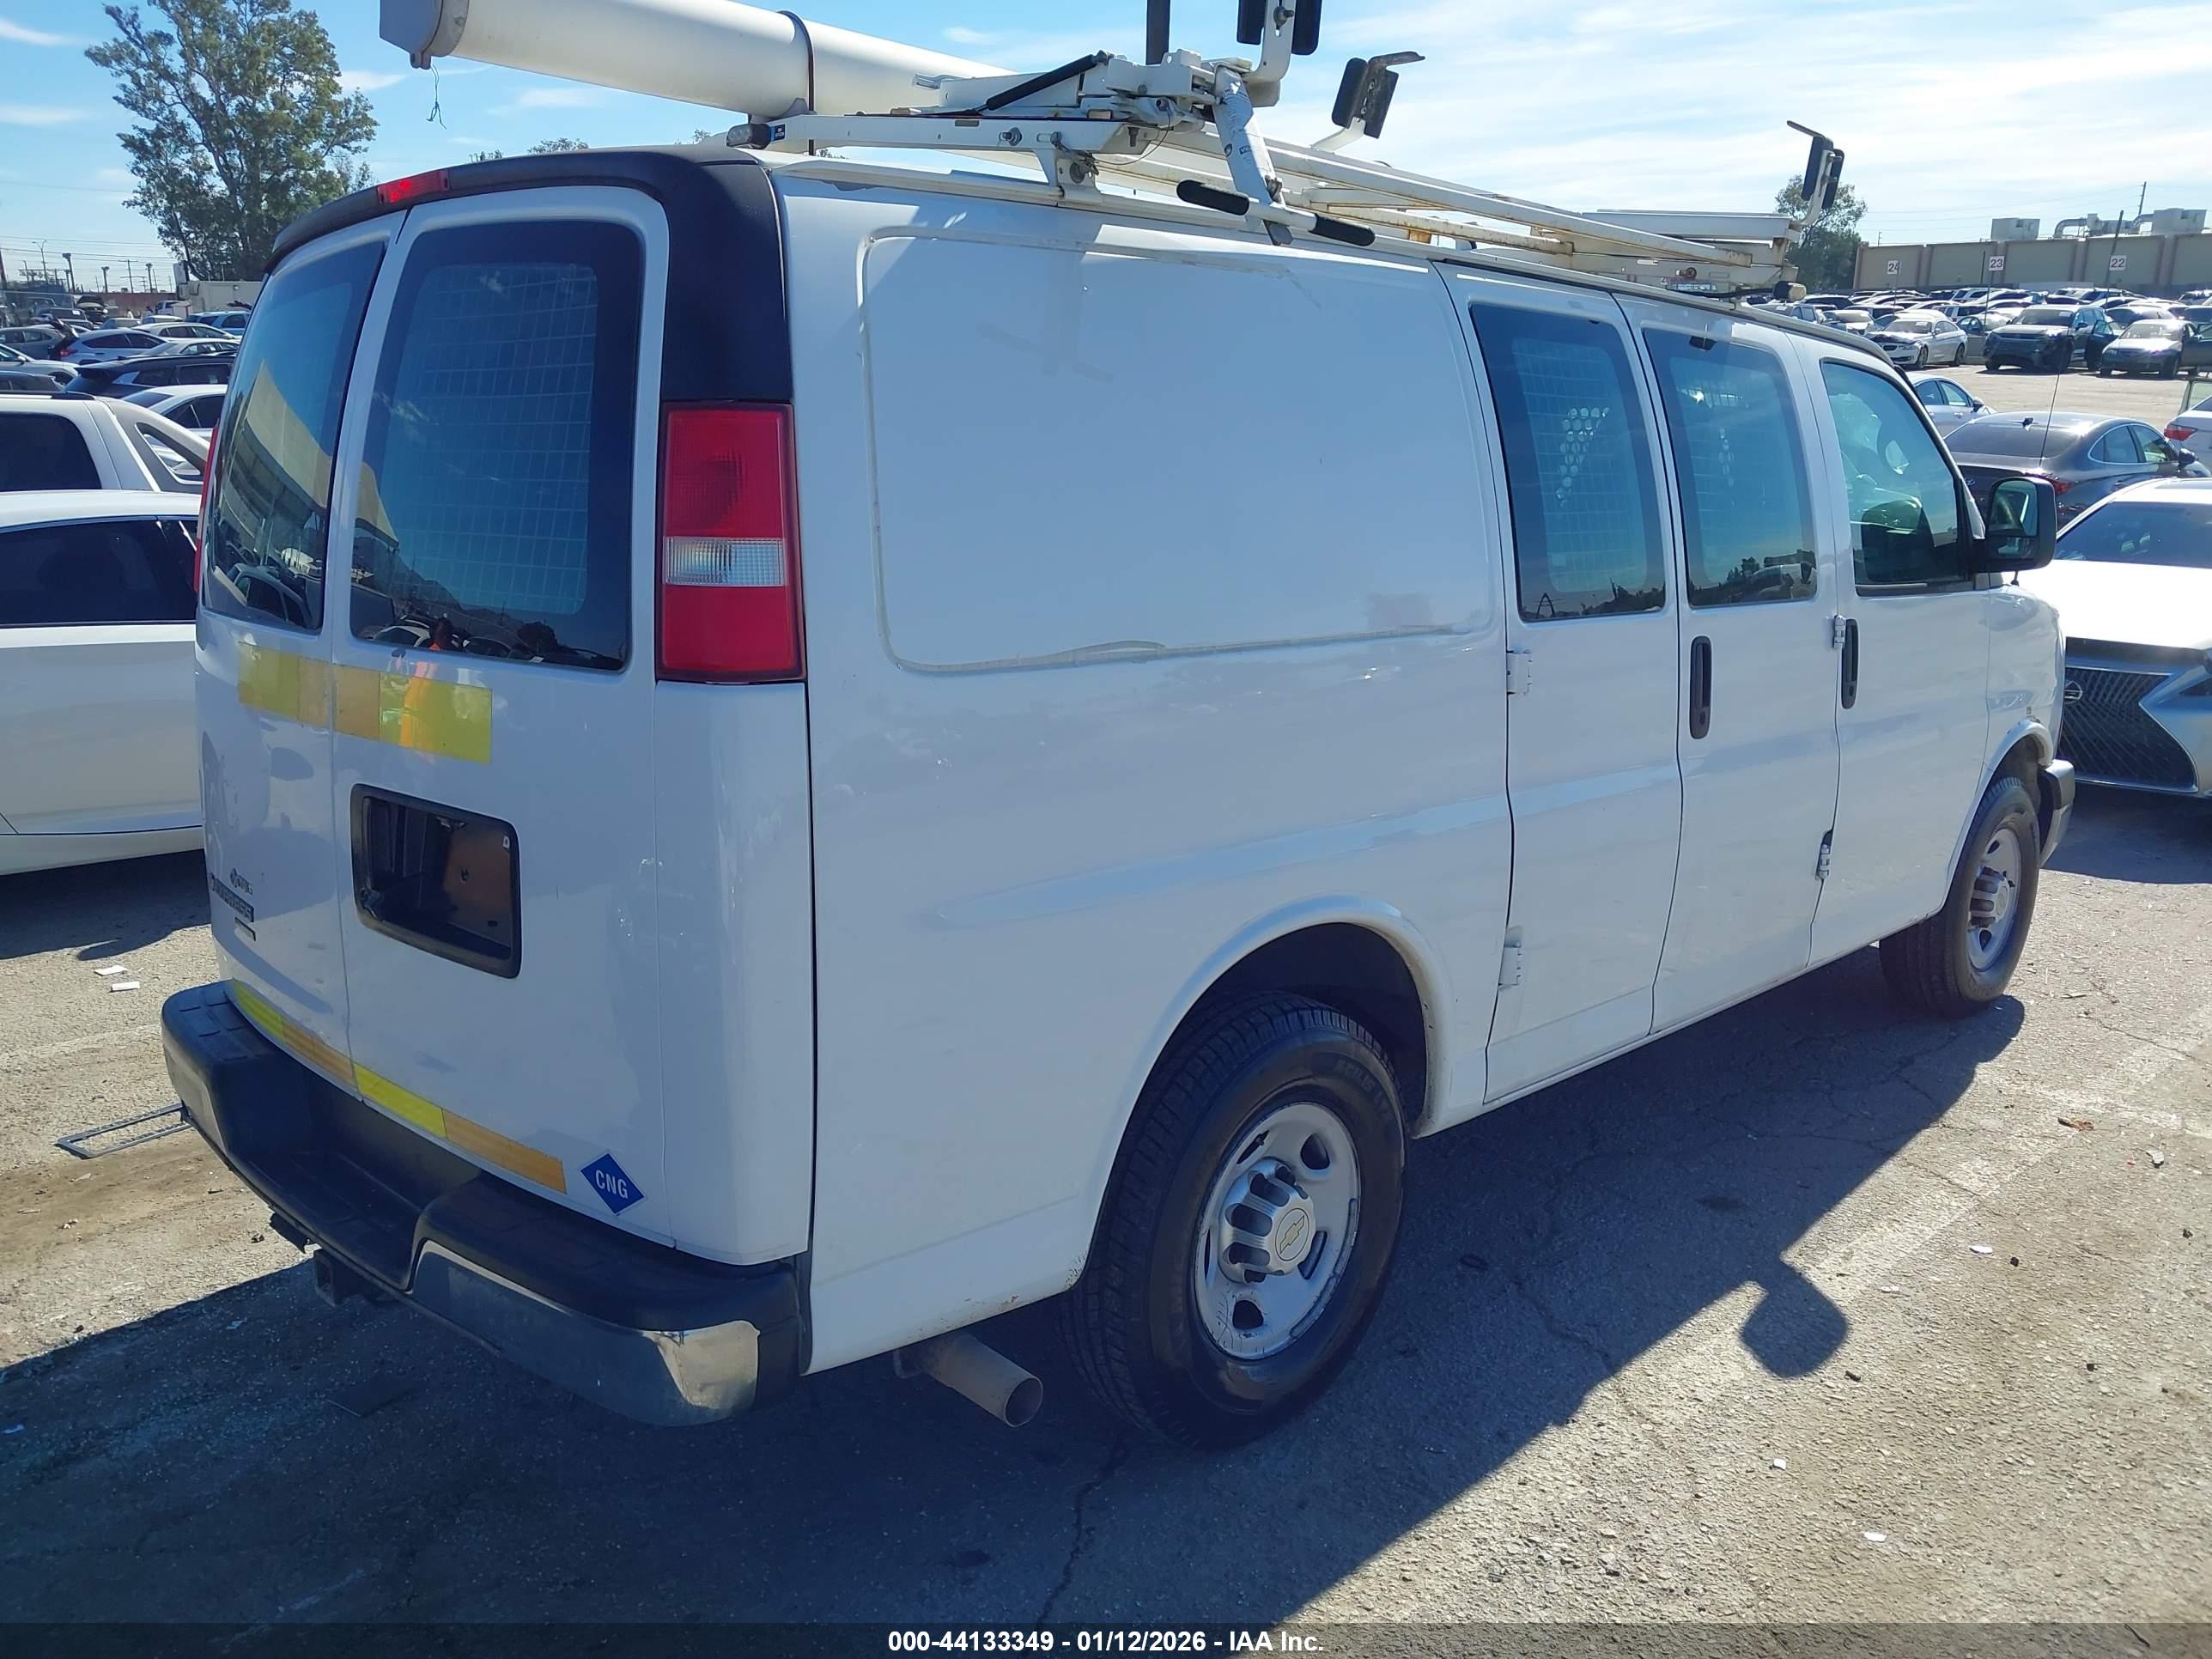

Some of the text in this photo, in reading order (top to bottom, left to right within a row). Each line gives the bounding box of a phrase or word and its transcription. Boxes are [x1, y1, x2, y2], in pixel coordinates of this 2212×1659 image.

[1990, 259, 2003, 269] 23
[2111, 258, 2124, 268] 22
[595, 1169, 629, 1200] CNG
